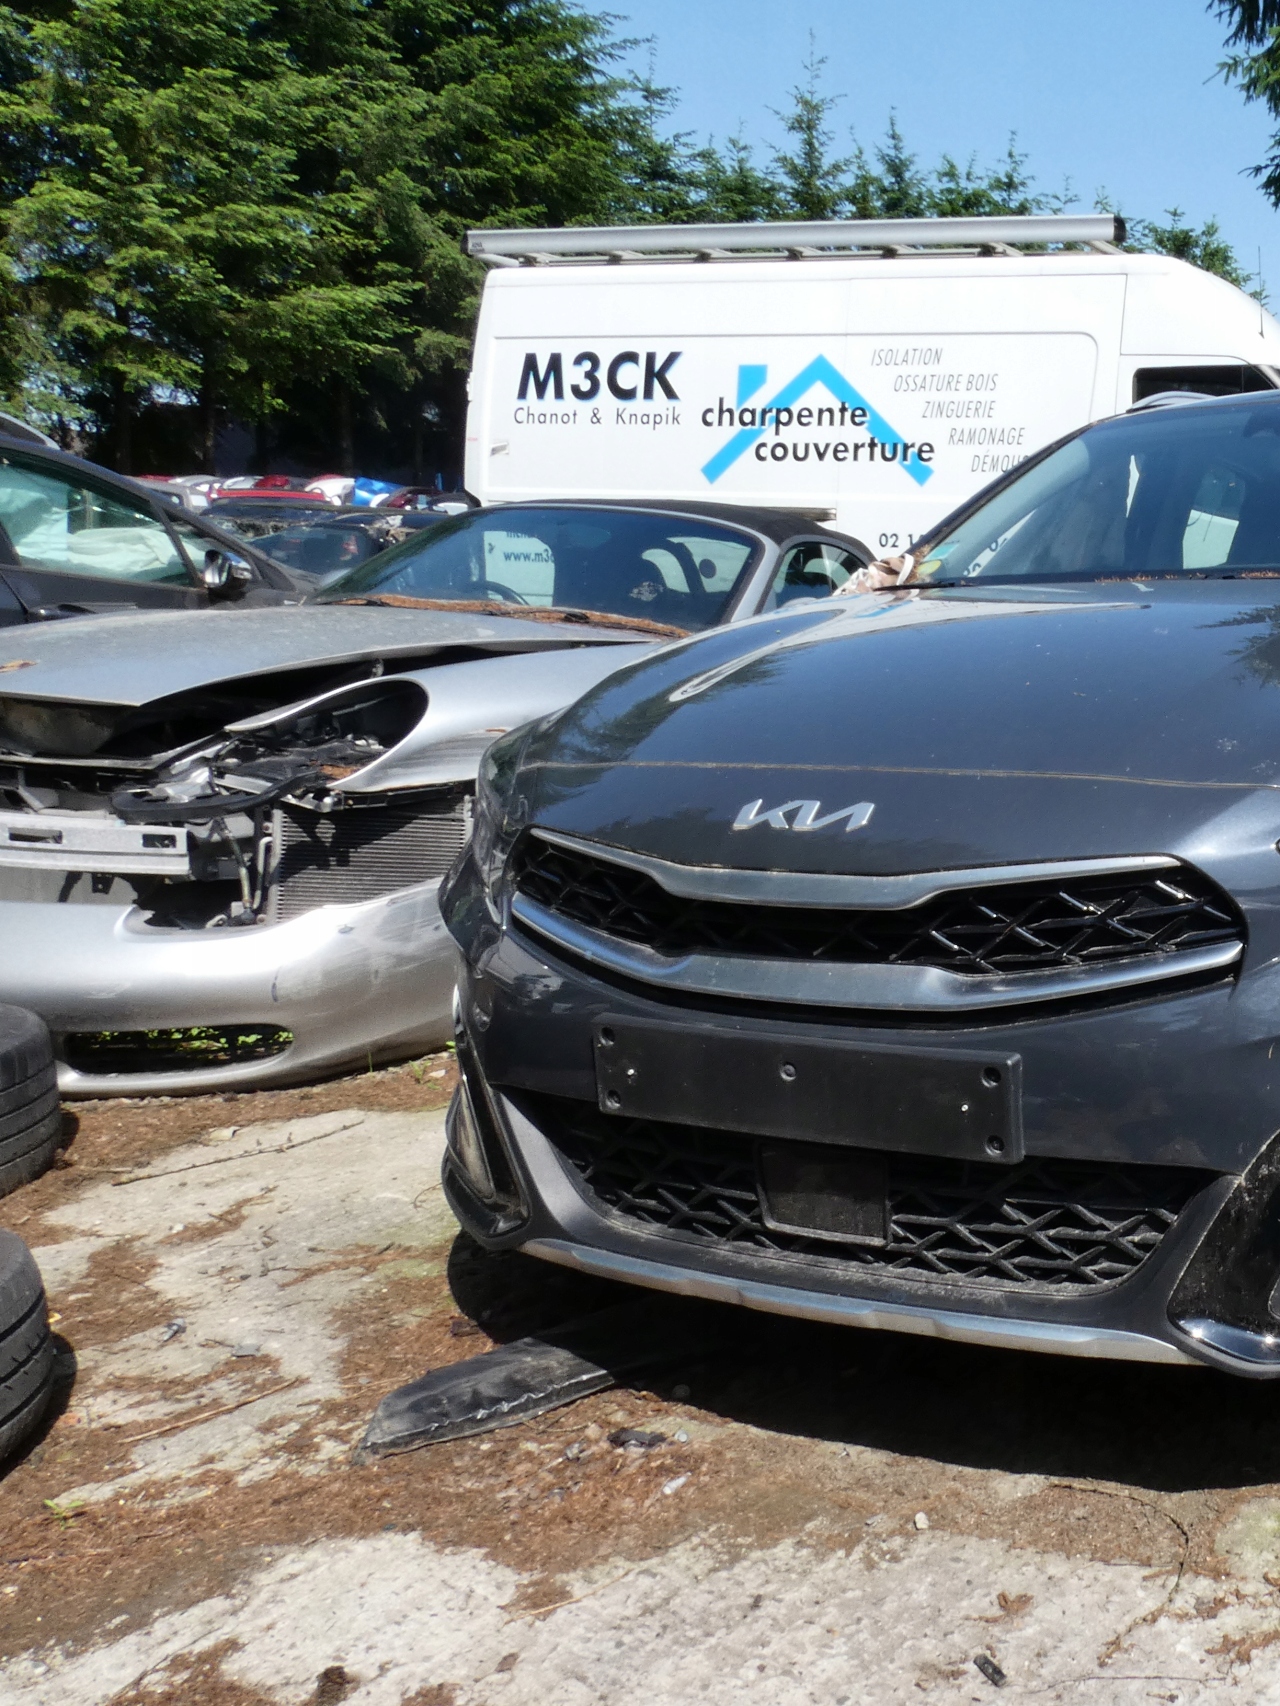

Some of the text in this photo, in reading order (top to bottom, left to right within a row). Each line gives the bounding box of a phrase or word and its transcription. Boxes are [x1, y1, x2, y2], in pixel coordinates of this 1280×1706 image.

[871, 348, 943, 366] ISOLATION
[517, 351, 683, 401] M3CK
[894, 373, 998, 392] OSSATURE BOIS
[514, 406, 681, 430] Chanot & Knapik
[701, 397, 868, 435] charpente
[922, 400, 996, 418] ZINGUERIE
[948, 427, 1025, 445] RAMONAGE
[755, 437, 935, 462] couverture
[971, 449, 1029, 473] DÉMOU
[879, 533, 899, 548] 02
[732, 798, 875, 832] KIA
